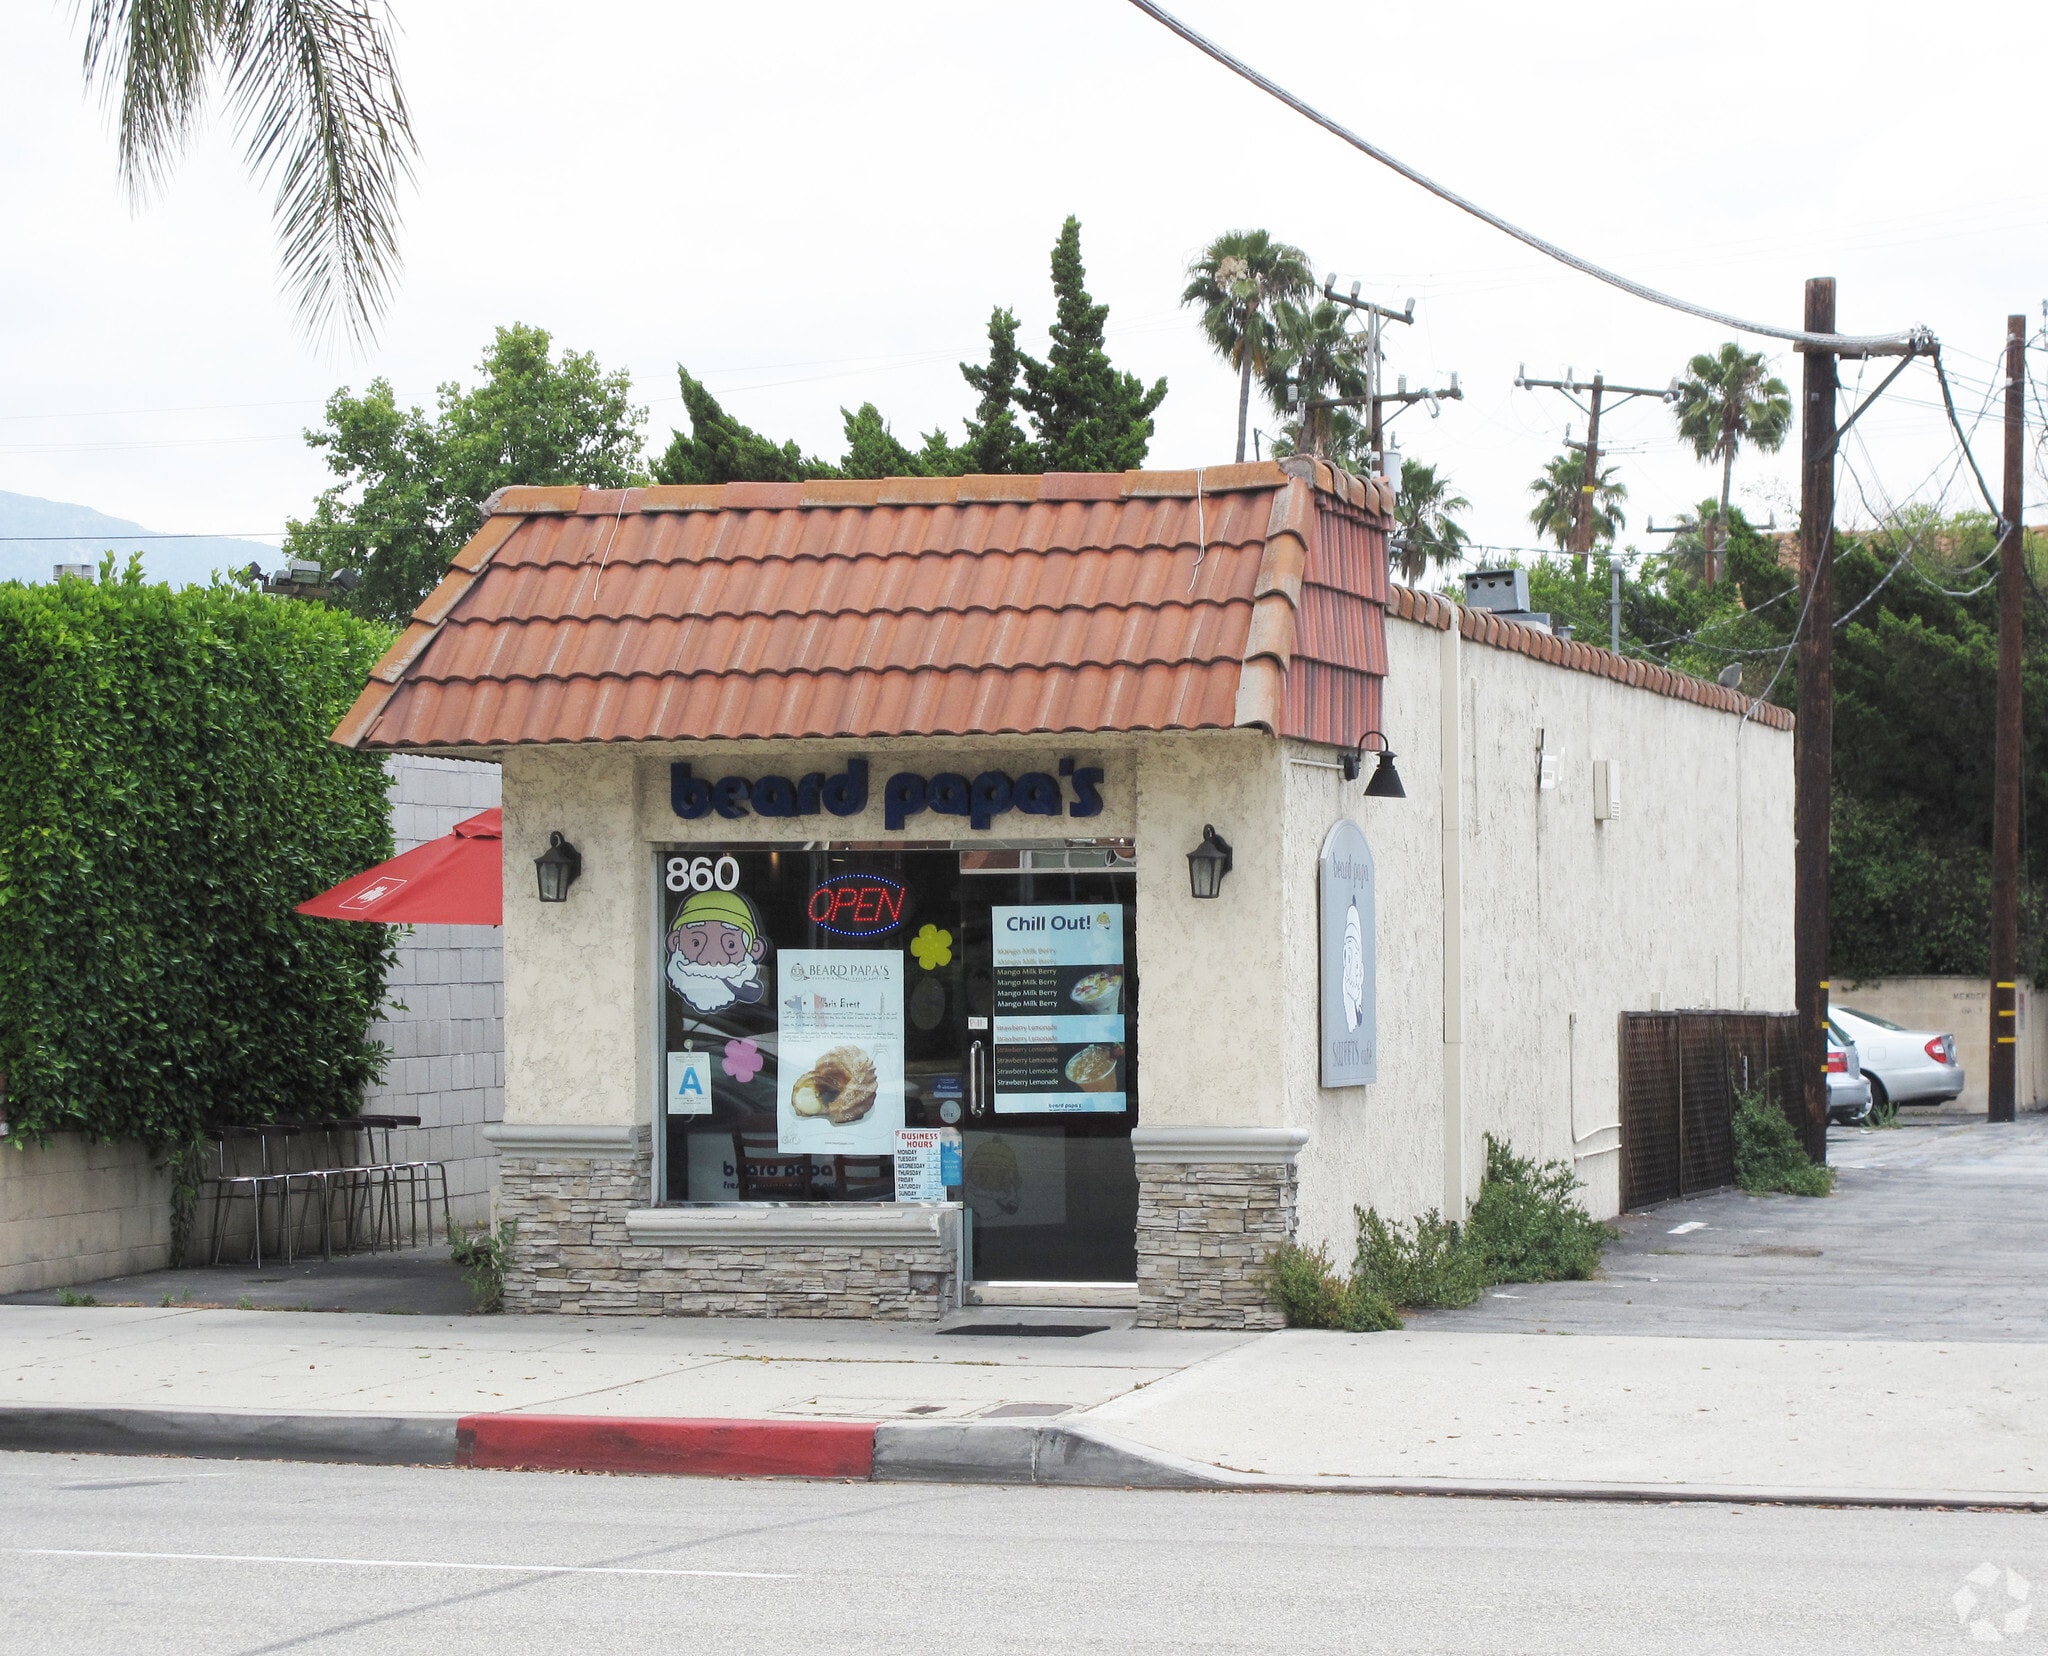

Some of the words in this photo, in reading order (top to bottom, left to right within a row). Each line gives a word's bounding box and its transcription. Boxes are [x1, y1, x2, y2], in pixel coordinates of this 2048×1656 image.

[671, 758, 868, 819] beard
[885, 758, 1104, 830] papa's
[666, 857, 739, 891] 860
[808, 888, 905, 921] OPEN
[1007, 917, 1045, 931] Chill
[1051, 915, 1091, 930] Out!
[809, 965, 847, 976] BEARD
[851, 965, 889, 976] PAPA'S
[679, 1067, 703, 1095] A
